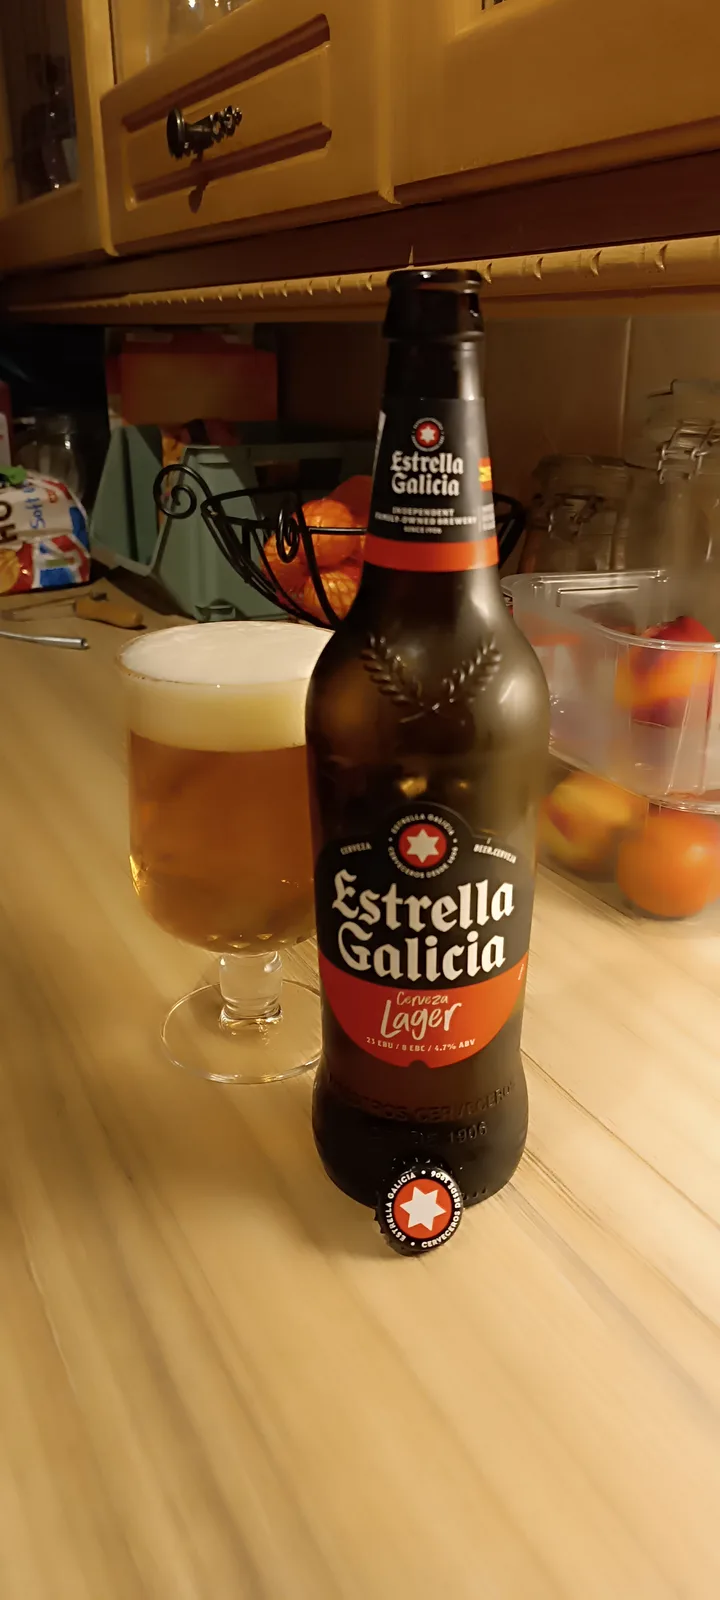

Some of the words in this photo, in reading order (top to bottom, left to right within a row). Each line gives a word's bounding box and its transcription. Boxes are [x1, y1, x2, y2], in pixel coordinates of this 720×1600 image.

[390, 451, 464, 475] Estrella
[391, 473, 460, 496] Galicia
[25, 498, 46, 530] Soft
[392, 506, 454, 517] INDEPENDENT
[437, 516, 477, 526] BREWERY
[391, 813, 425, 834] ESTRELLA
[427, 813, 455, 836] GALICIA
[340, 842, 372, 855] CERVEZA
[388, 846, 425, 879] CERVECEROS
[426, 862, 449, 878] DESDE
[332, 868, 515, 933] Estrella
[338, 921, 506, 982] Galicia
[397, 991, 449, 1007] Cerveza
[380, 999, 463, 1041] Lager
[377, 1039, 394, 1049] EBU
[409, 1044, 426, 1052] EBC
[434, 1042, 457, 1052] 4.7%
[458, 1038, 476, 1049] ABV
[448, 1120, 489, 1145] 1906
[387, 1172, 416, 1199] GALICIA
[385, 1201, 406, 1242] ESTRELLA
[421, 1211, 461, 1248] CERVECEROS
[447, 1182, 461, 1209] DESDE
